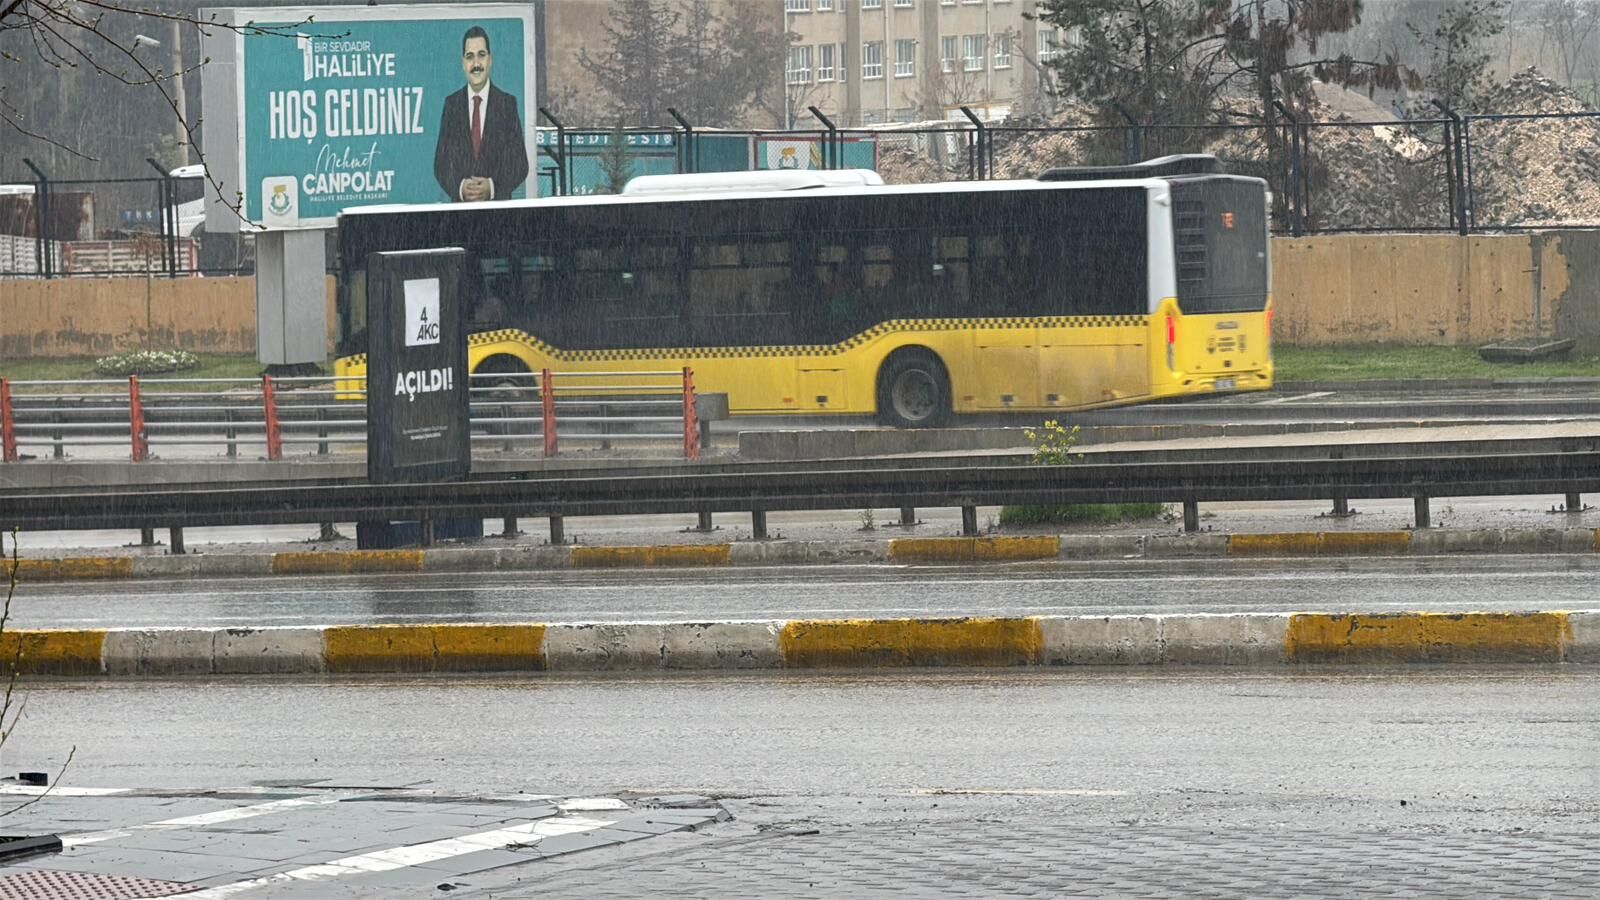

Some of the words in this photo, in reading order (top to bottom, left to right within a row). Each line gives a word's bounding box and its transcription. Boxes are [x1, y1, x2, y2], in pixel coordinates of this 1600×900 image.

[270, 89, 317, 144] HOŞ
[325, 86, 424, 137] GELDİNİZ
[315, 141, 382, 182] Mehmet
[302, 170, 395, 195] CANPOLAT
[420, 306, 428, 323] 4
[416, 323, 440, 341] AKC
[395, 366, 453, 402] AÇILDI!
